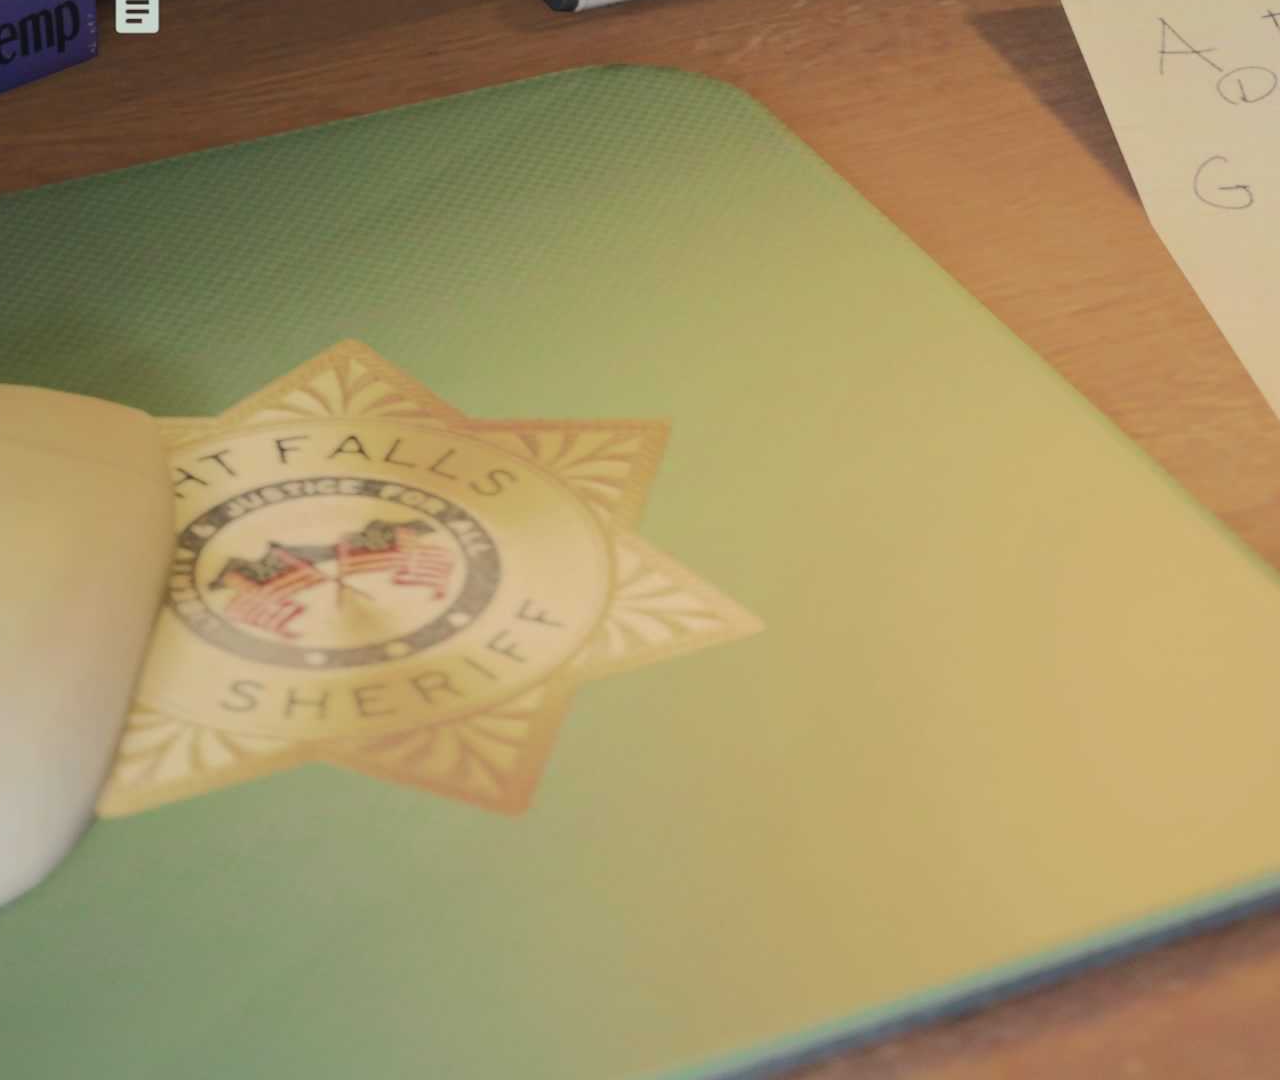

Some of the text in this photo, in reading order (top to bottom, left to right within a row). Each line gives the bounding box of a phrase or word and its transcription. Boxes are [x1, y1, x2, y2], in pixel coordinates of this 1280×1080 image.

[1157, 17, 1224, 76] A
[1193, 155, 1255, 211] G
[275, 434, 517, 497] FALLS
[220, 597, 566, 720] SHERIFF
